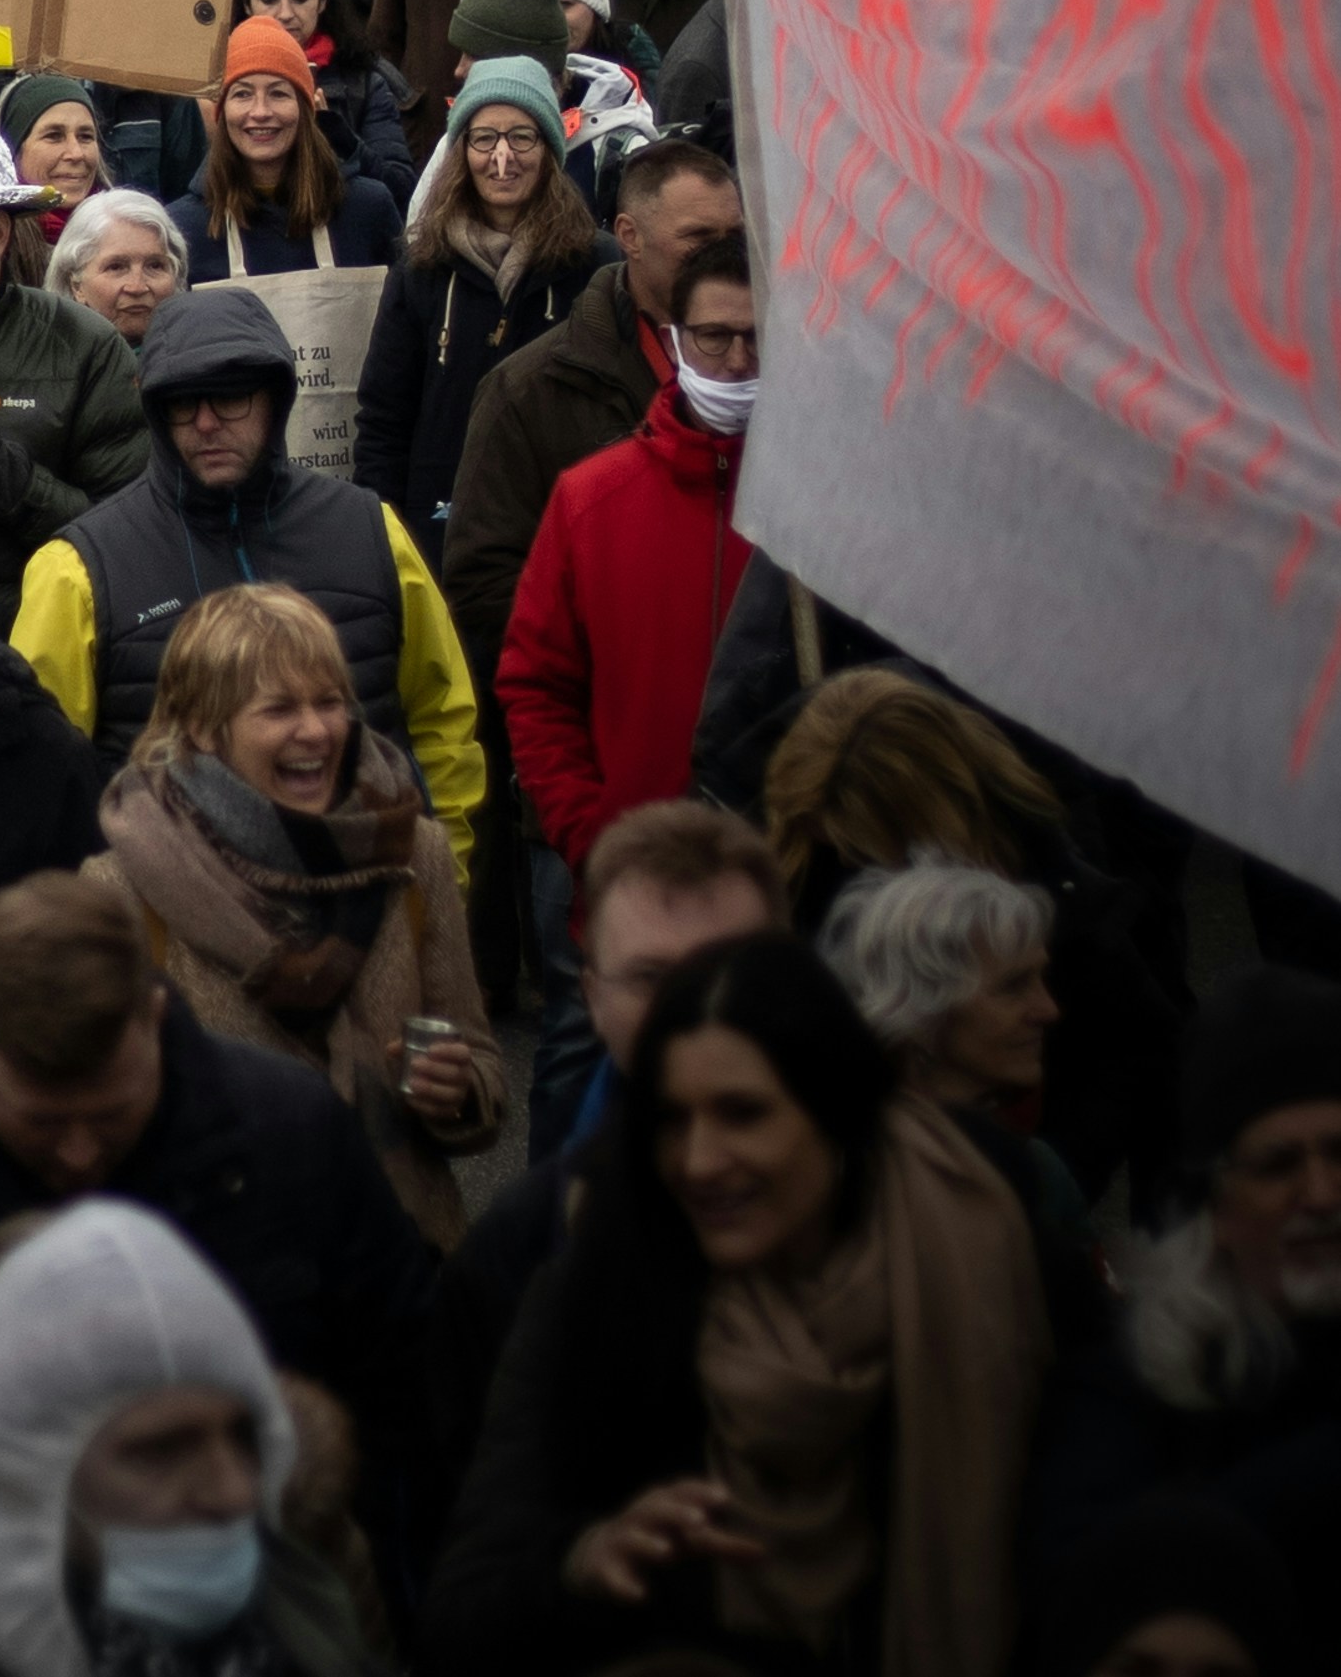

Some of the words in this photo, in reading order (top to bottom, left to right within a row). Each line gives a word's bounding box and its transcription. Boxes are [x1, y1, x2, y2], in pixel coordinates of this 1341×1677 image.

[311, 346, 331, 361] zu
[2, 396, 36, 410] sherpa
[312, 420, 349, 441] wird
